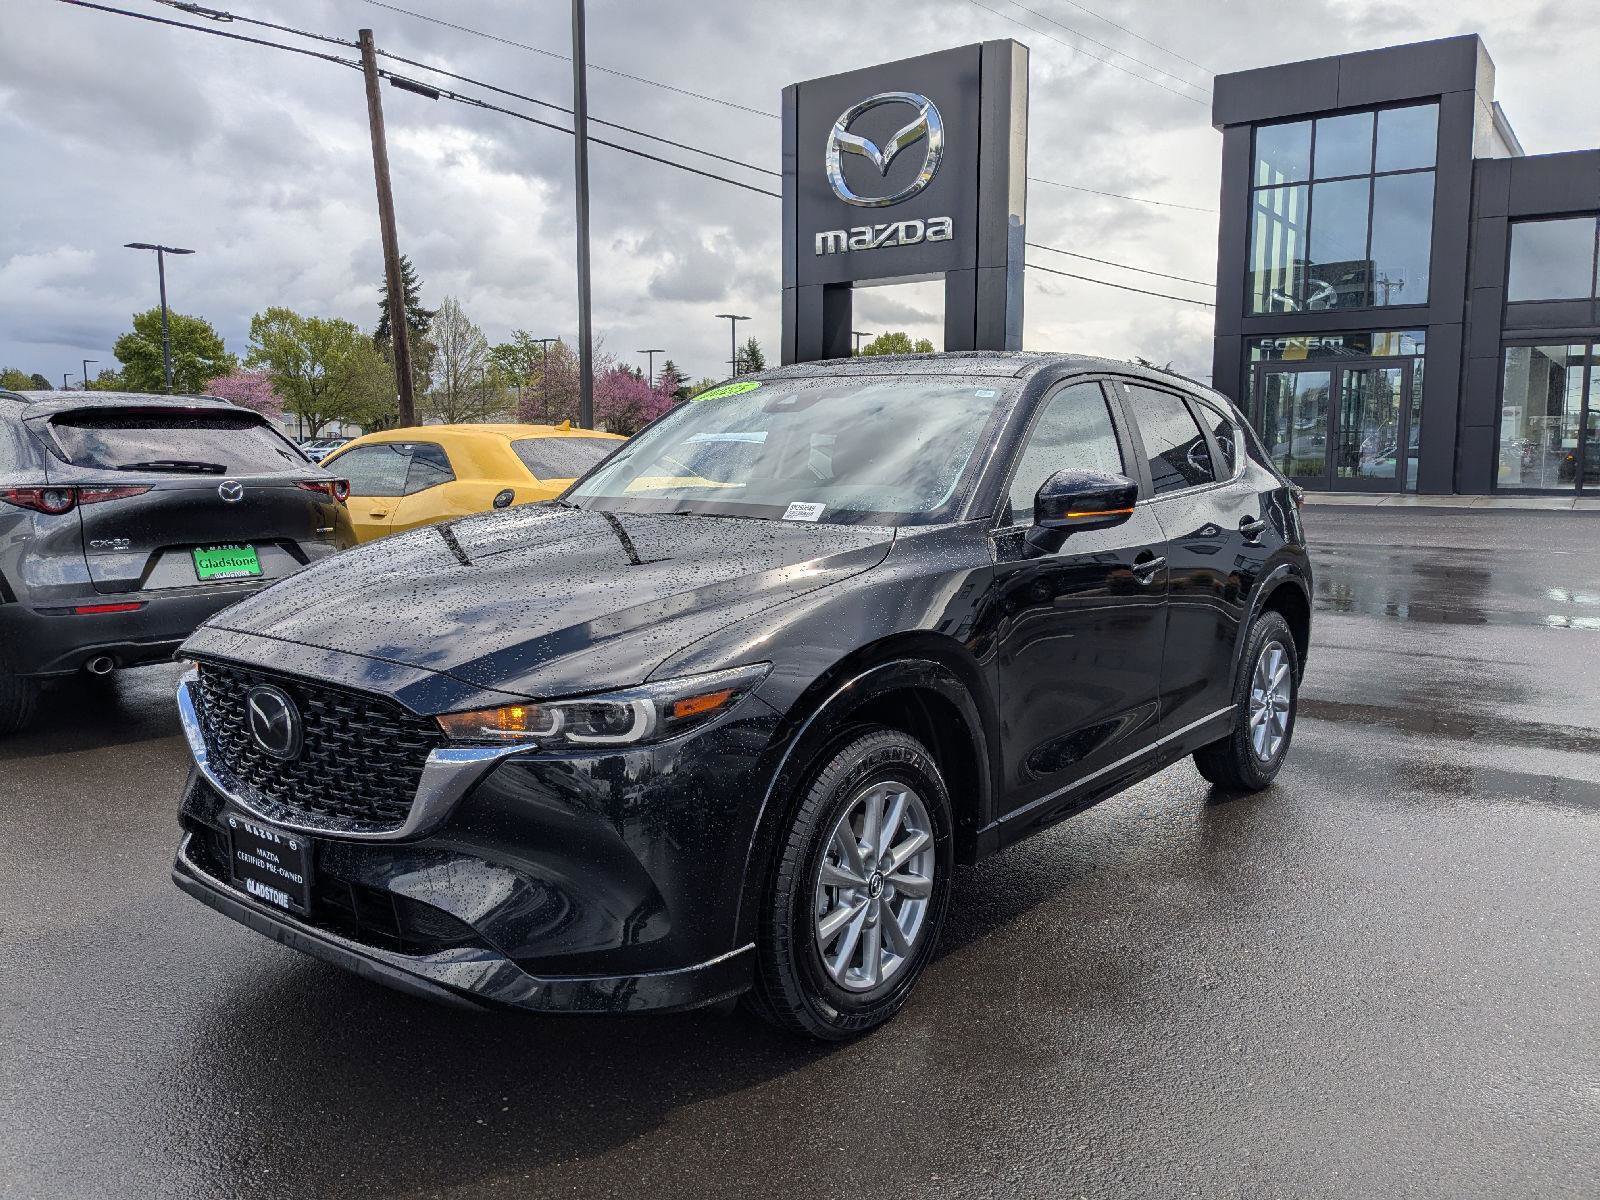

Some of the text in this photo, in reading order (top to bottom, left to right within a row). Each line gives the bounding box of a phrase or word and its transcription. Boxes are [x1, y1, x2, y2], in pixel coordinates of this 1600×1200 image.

[198, 557, 257, 569] Gladstone
[244, 823, 281, 844] MAZDA
[256, 847, 280, 864] MAZDA
[237, 850, 303, 884] CERTIFIED PRE-OWNED
[246, 878, 289, 909] GLADSTONE
